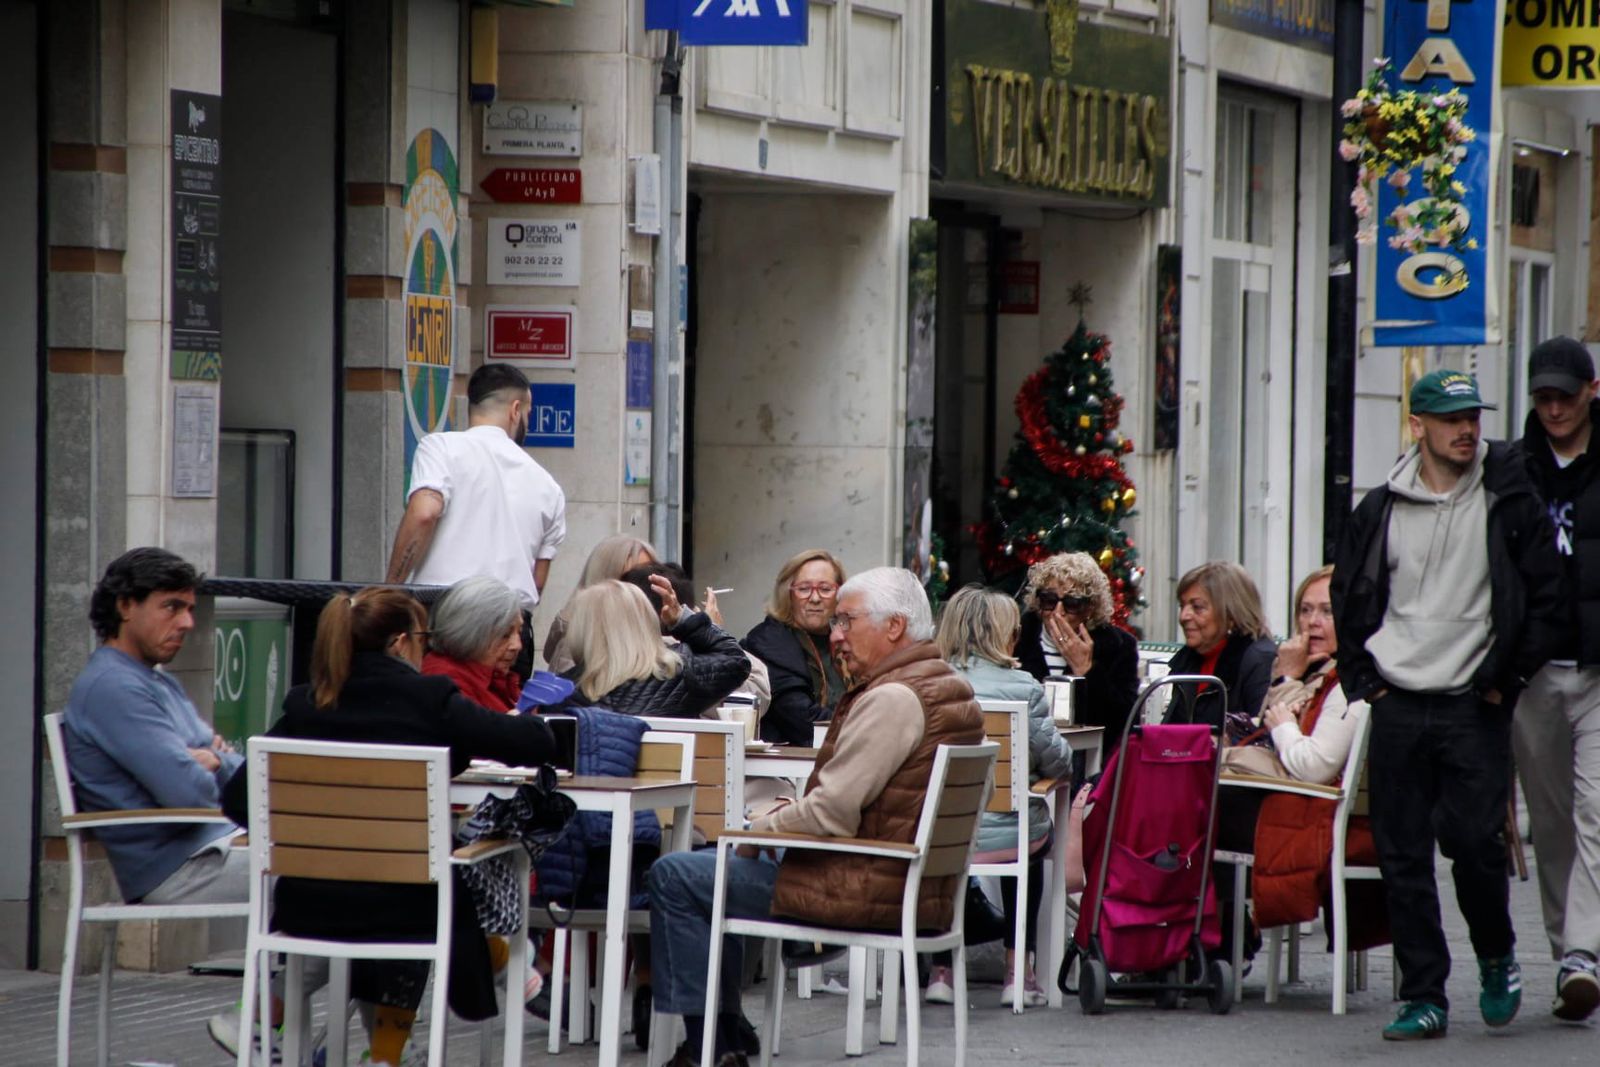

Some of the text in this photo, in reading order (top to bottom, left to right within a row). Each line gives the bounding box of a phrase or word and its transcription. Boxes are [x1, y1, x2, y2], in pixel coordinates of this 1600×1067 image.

[1504, 0, 1600, 28] OM
[1532, 44, 1600, 80] OR
[964, 64, 1157, 199] VERSAILLES
[502, 140, 565, 149] PRIMERA PLANTA
[505, 171, 575, 183] PUBLICIDAD
[525, 224, 558, 235] grupo
[525, 233, 562, 244] control
[504, 256, 563, 265] 902 26 22 22
[406, 294, 451, 366] CENTRO
